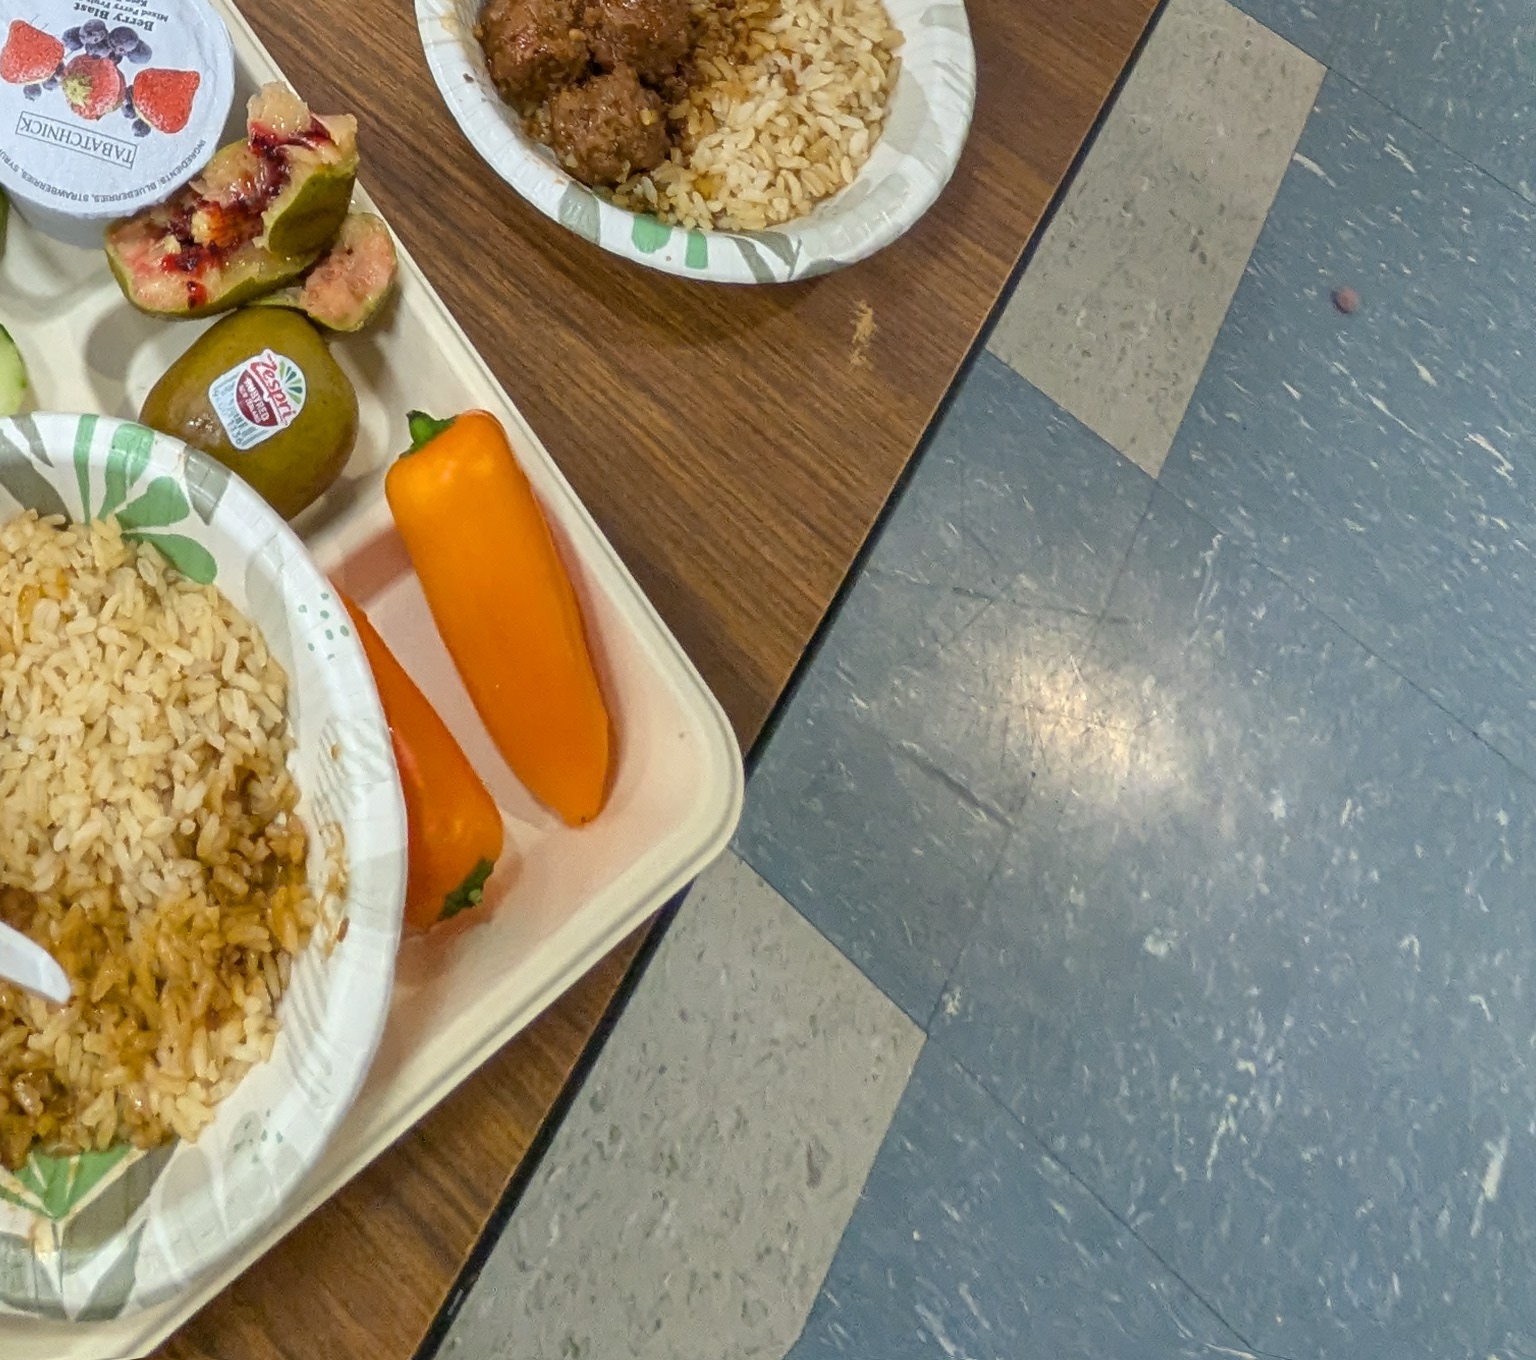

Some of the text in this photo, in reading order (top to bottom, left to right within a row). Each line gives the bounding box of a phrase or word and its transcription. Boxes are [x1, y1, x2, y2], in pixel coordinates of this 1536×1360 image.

[73, 2, 155, 32] Berry Blast
[141, 8, 169, 23] Mixed
[20, 118, 133, 164] TABATCHNICK
[21, 169, 89, 202] STRAWBERRIES,
[250, 359, 297, 420] Zespri
